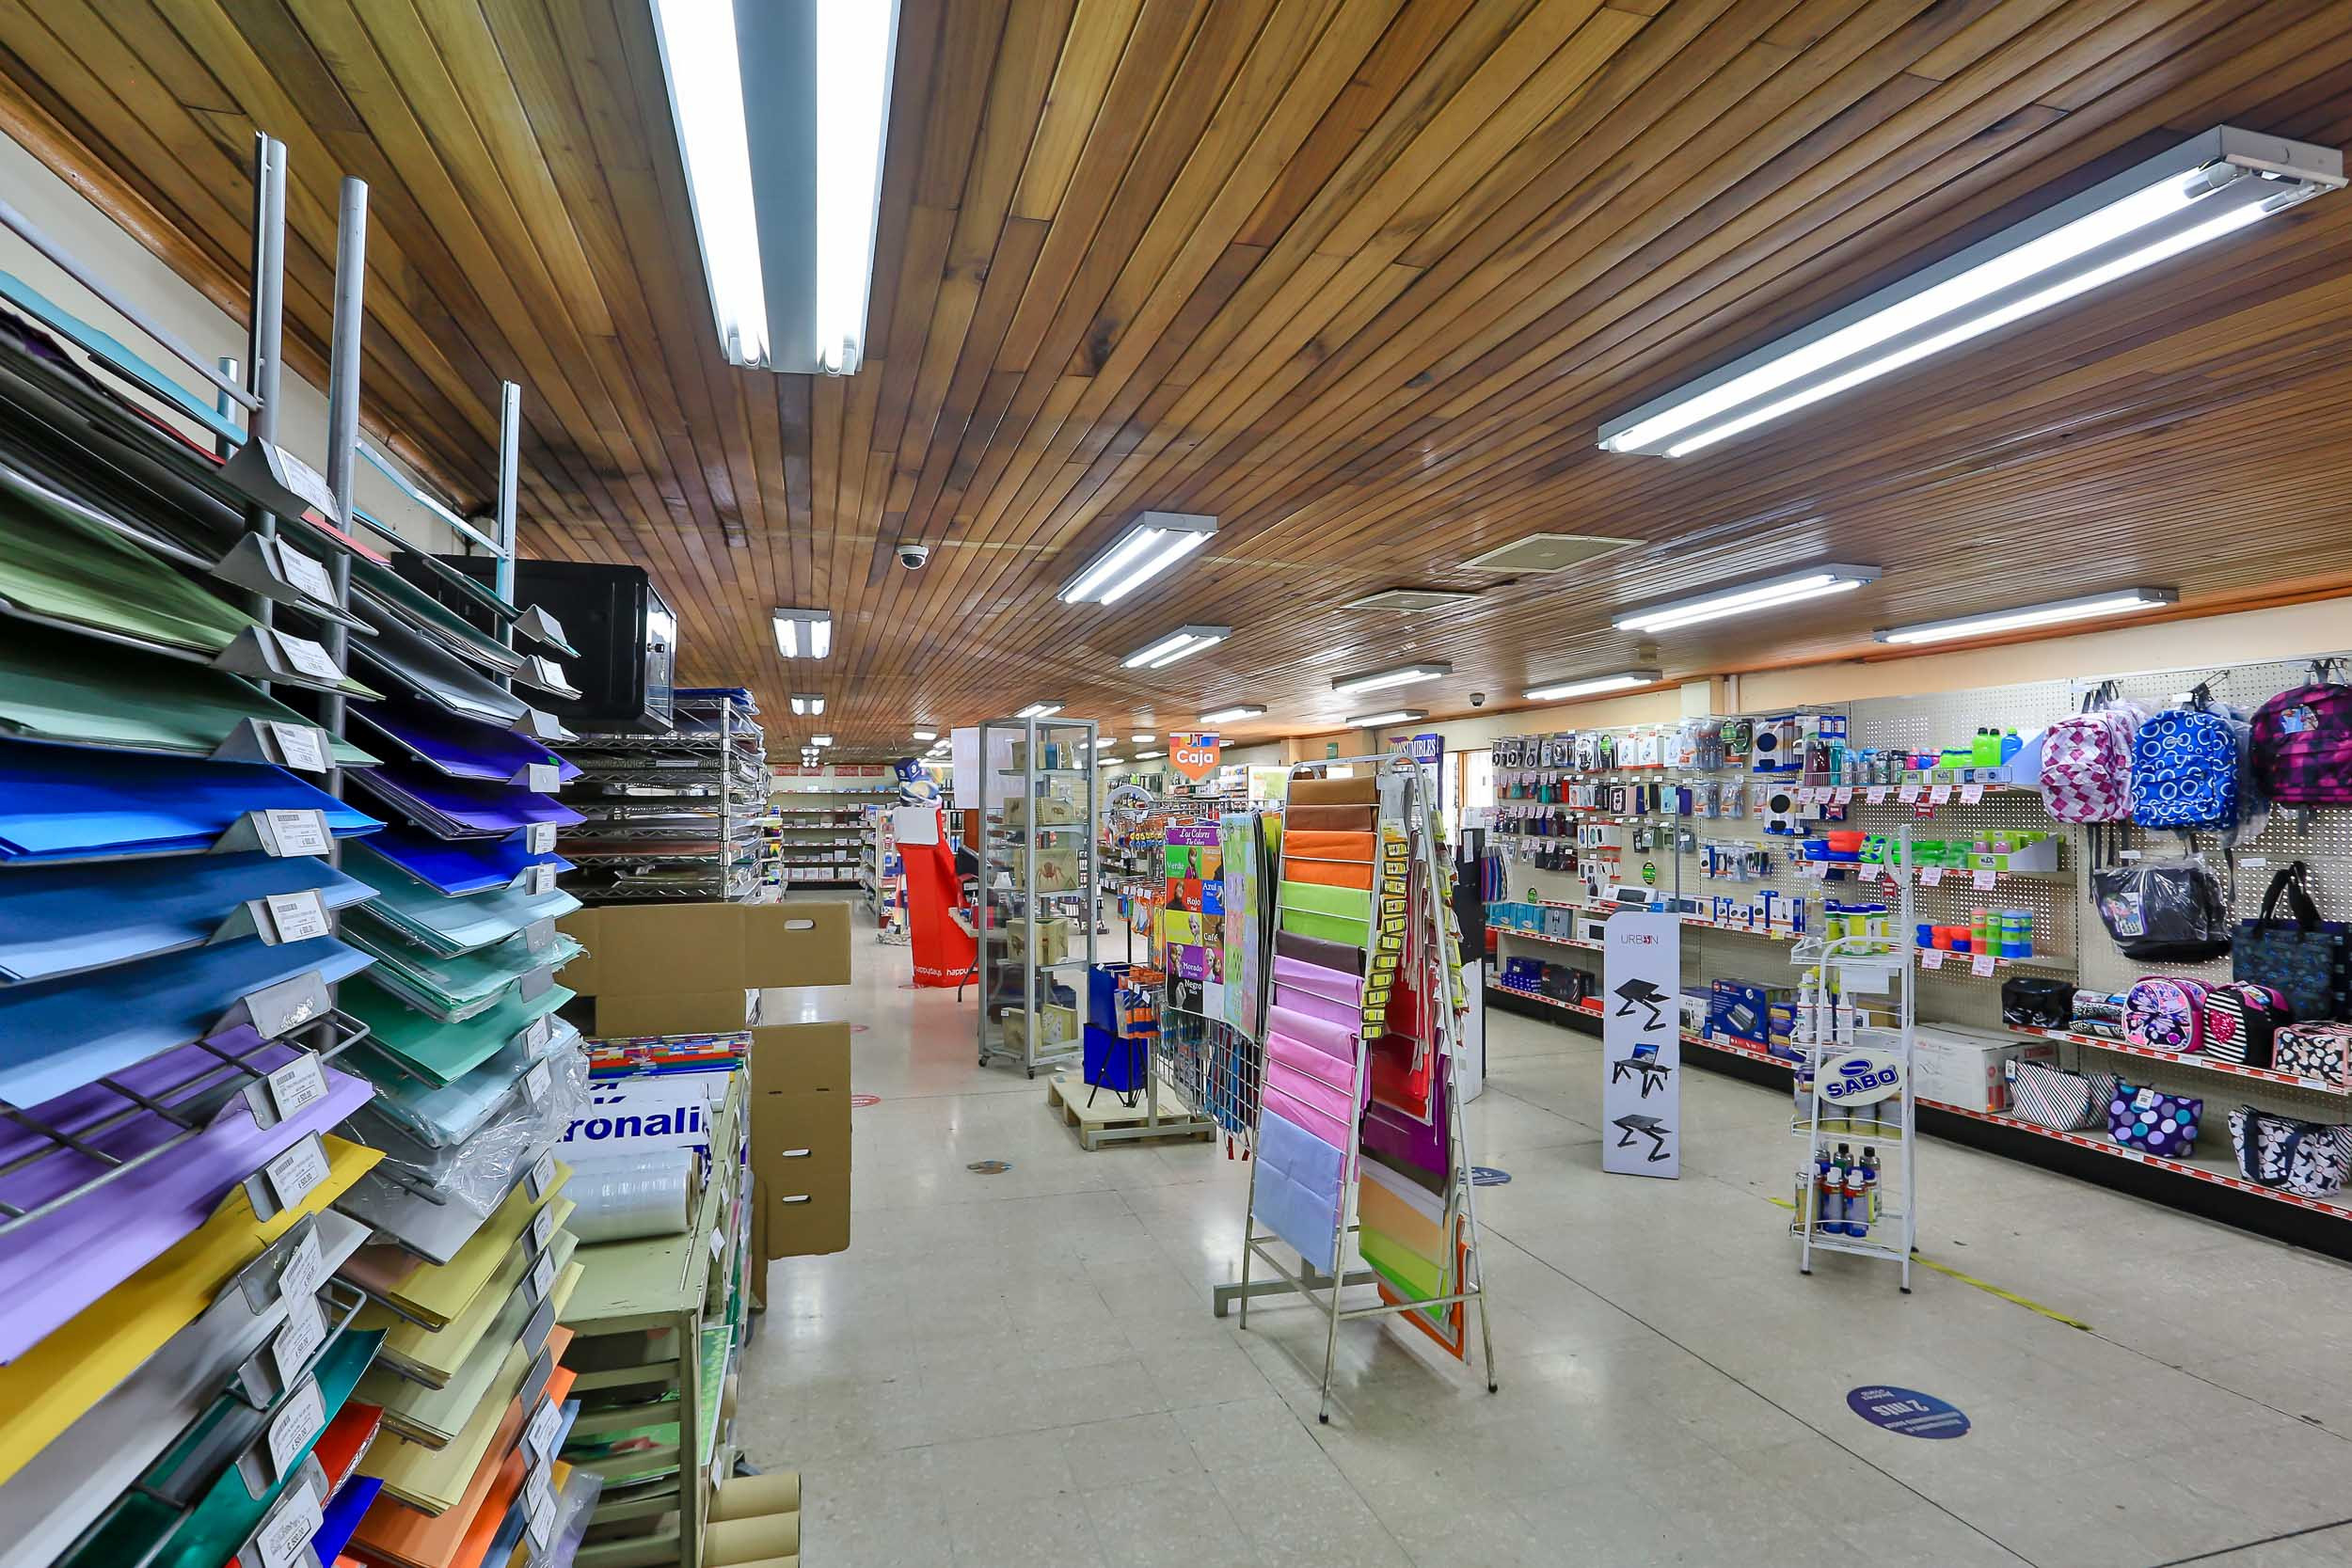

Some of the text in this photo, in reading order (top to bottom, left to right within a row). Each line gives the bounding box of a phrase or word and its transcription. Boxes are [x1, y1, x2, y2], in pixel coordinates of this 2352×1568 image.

[1186, 734, 1203, 746] JT
[1176, 749, 1214, 768] Caja
[1202, 882, 1217, 891] Azul
[1186, 896, 1201, 907] Rojo
[1203, 932, 1218, 942] Café
[1184, 979, 1202, 990] Negro
[1826, 1069, 1899, 1099] SABO
